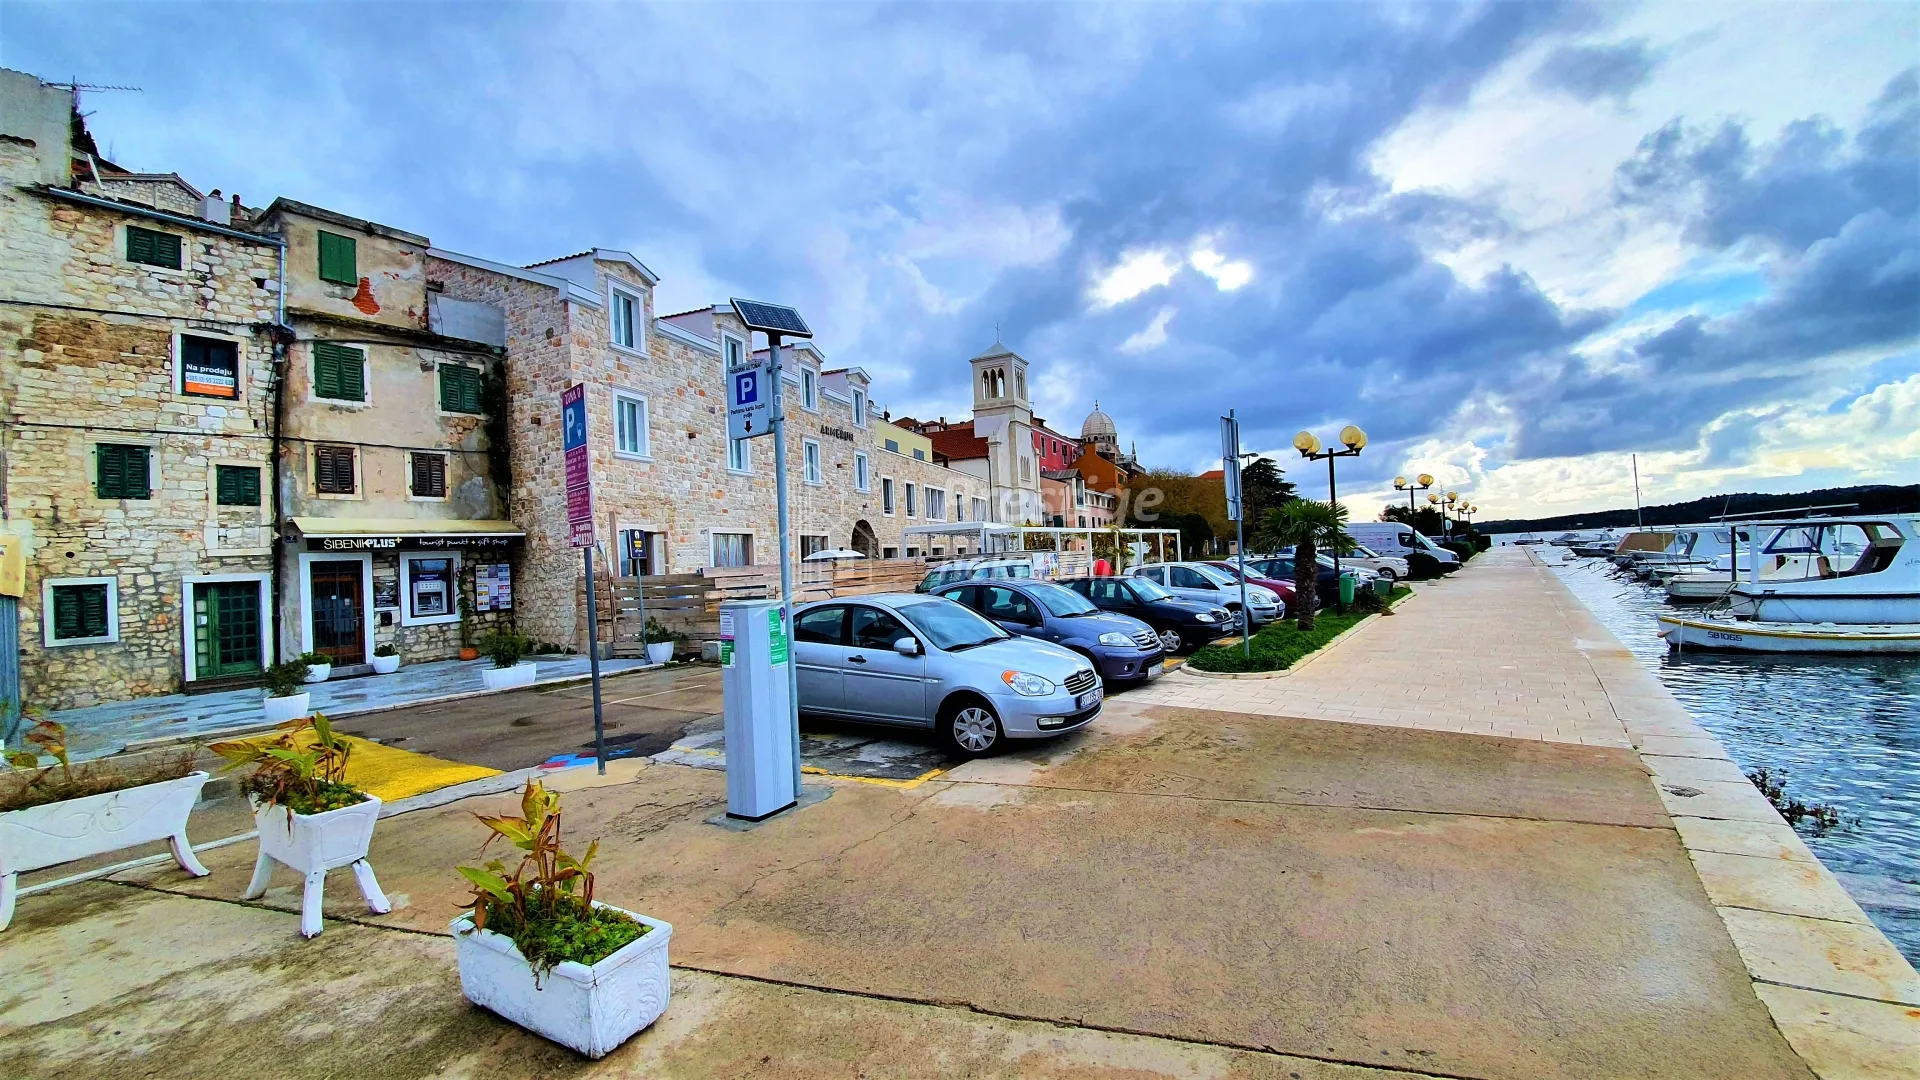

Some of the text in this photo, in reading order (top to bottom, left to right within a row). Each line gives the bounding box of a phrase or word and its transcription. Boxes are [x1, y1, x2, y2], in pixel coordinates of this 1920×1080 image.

[200, 366, 233, 376] prodaju
[740, 377, 754, 401] P
[566, 407, 575, 444] P
[419, 538, 444, 547] tourist
[477, 537, 490, 547] gift
[492, 538, 508, 547] shop
